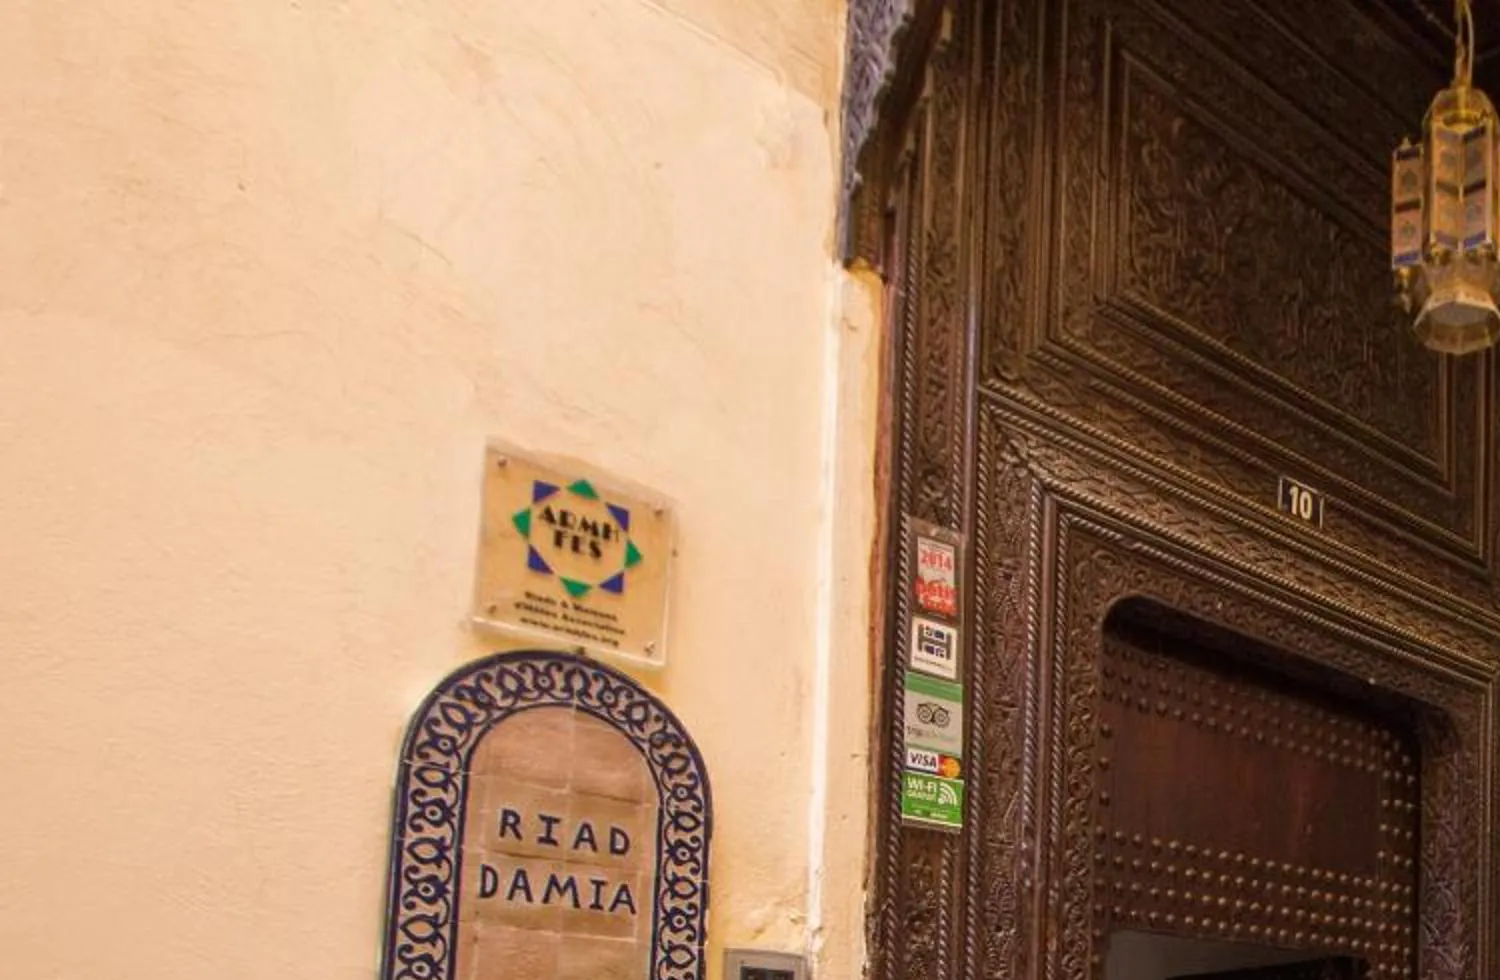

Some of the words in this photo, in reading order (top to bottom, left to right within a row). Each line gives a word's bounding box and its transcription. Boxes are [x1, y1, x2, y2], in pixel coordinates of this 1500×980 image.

[1289, 486, 1313, 520] 10
[910, 751, 938, 769] VISA
[499, 808, 631, 856] RIAD
[478, 863, 638, 915] DAMIA
